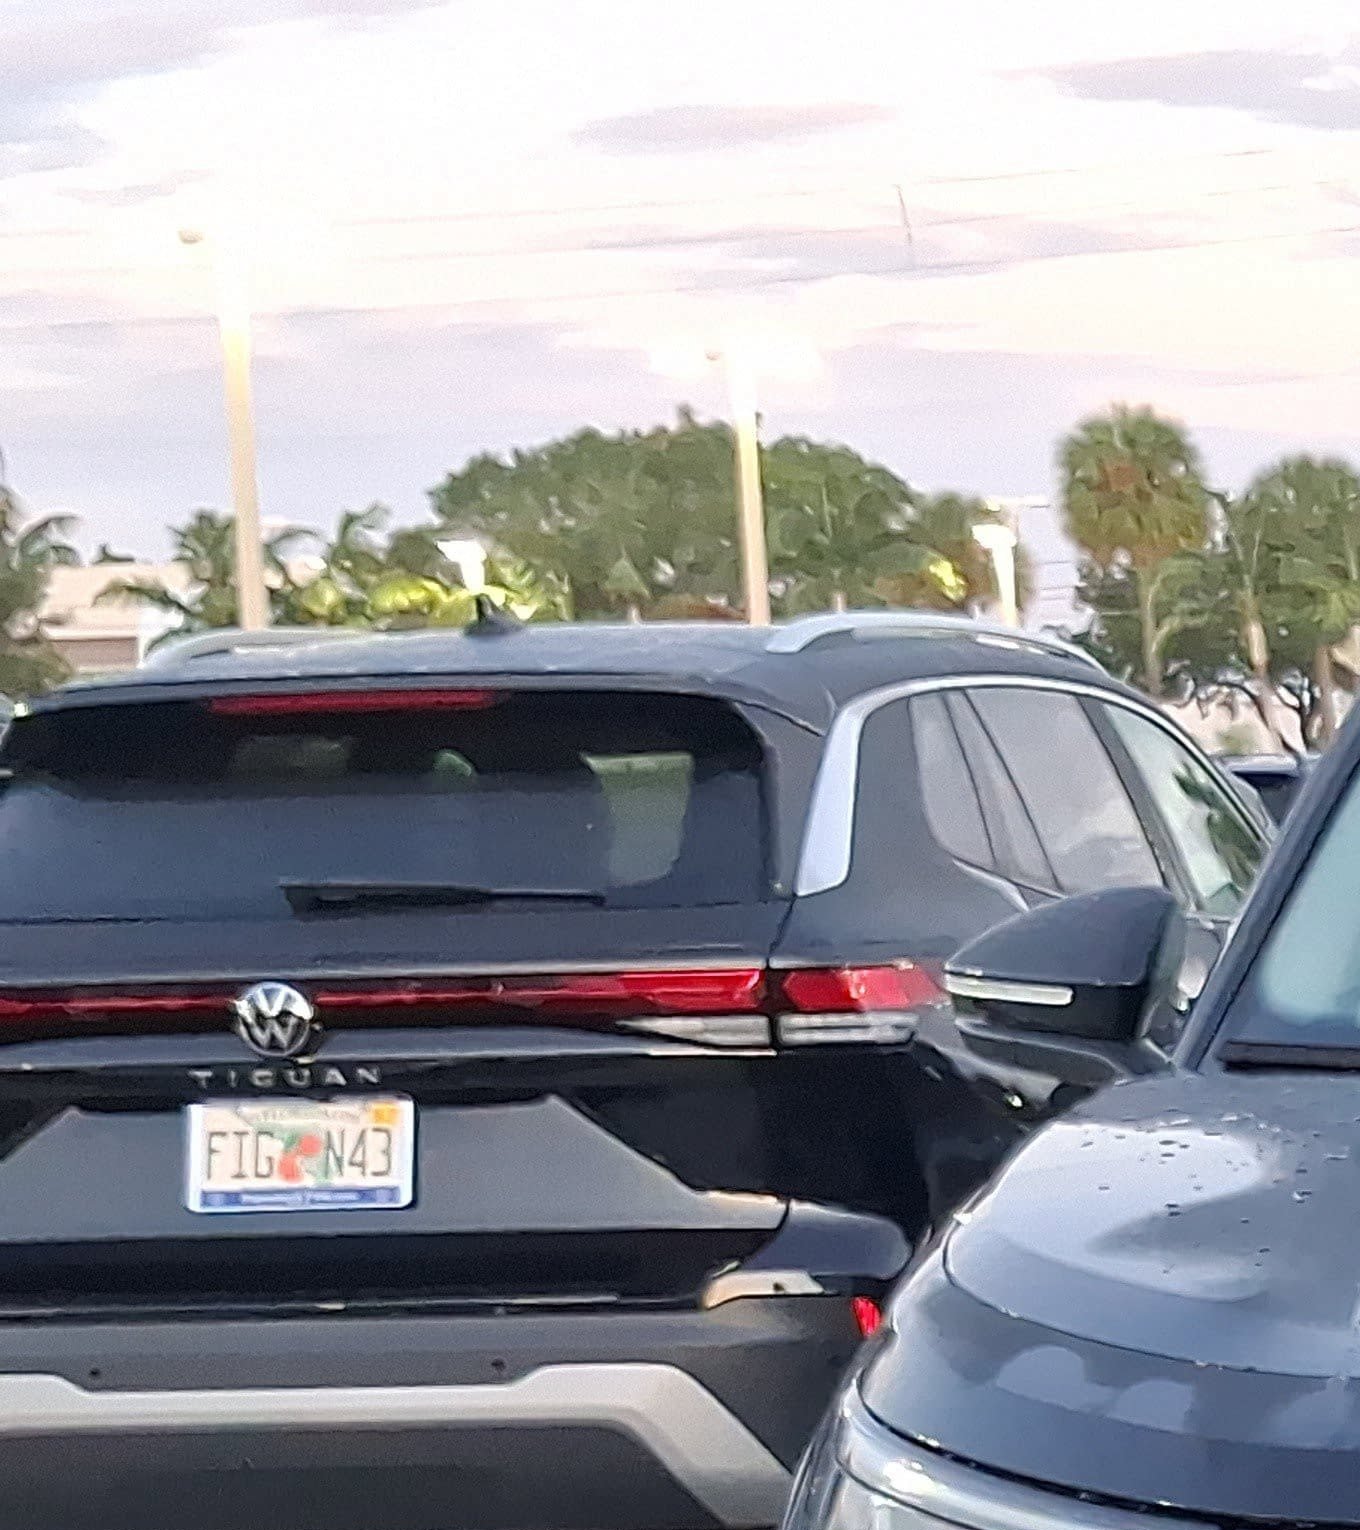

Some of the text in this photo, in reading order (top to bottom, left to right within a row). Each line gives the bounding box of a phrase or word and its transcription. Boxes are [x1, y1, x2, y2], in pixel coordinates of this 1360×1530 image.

[188, 1065, 383, 1089] TIGUAN
[206, 1126, 394, 1180] FIG N43
